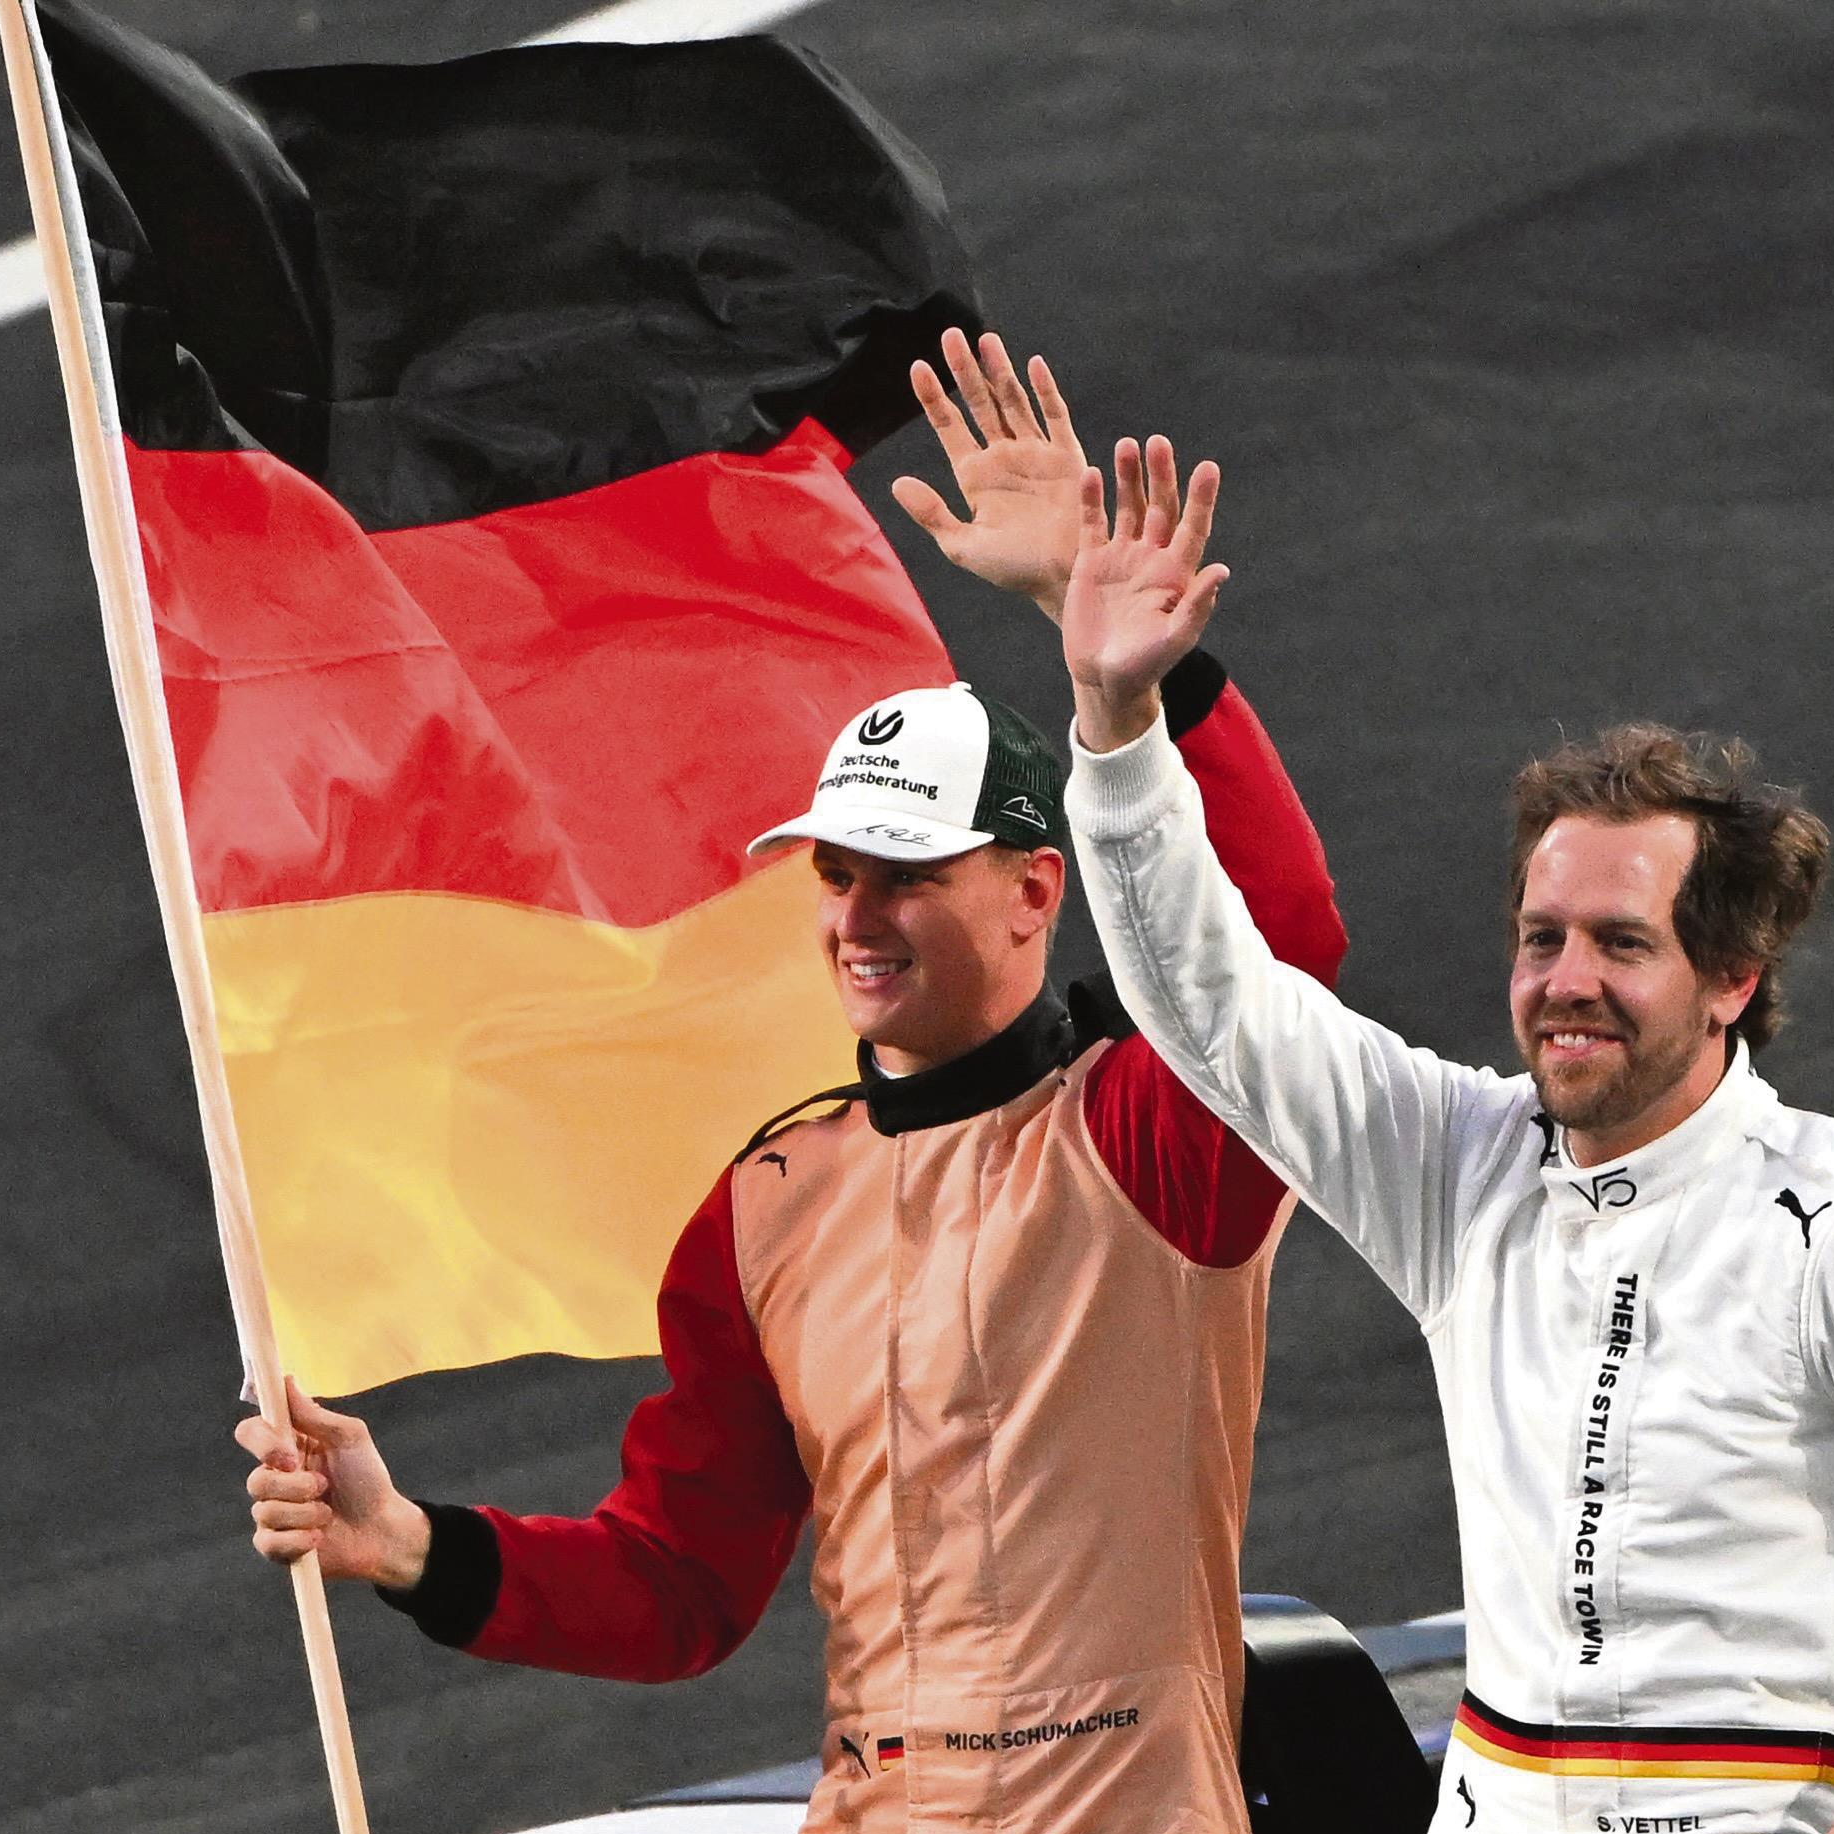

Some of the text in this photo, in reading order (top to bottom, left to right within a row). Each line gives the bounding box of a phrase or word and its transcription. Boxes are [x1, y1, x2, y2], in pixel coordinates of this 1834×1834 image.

[1607, 1274, 1638, 1359] THERE
[1597, 1363, 1620, 1388] IS
[1585, 1394, 1611, 1469] STILL
[1583, 1475, 1605, 1494] A
[1574, 1501, 1604, 1576] RACE
[945, 1708, 1139, 1752] MICK SCHUMACHER
[1620, 1815, 1707, 1834] VETTEL
